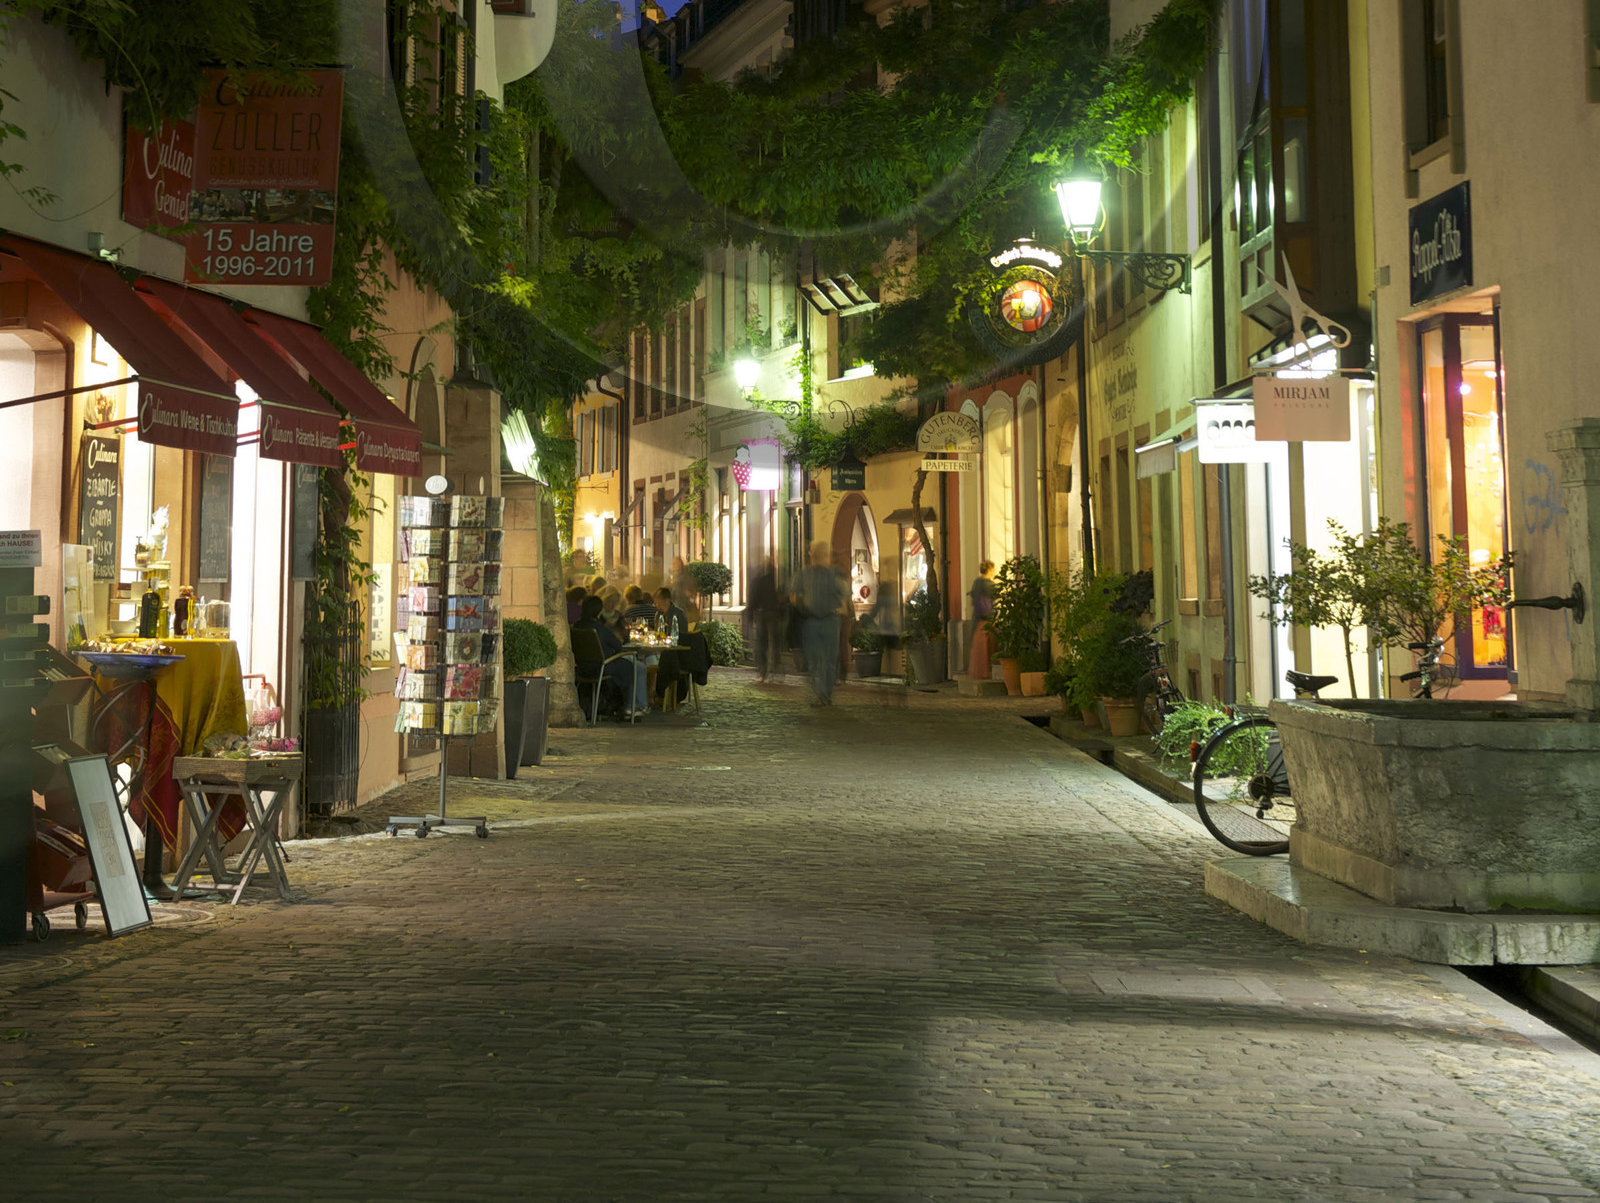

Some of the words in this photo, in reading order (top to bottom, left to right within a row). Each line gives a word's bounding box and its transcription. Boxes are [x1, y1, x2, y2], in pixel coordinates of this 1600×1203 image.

[211, 111, 323, 151] ZOLLER
[208, 156, 320, 177] GENUSSKULTUR
[203, 229, 232, 251] 15
[241, 229, 313, 253] Jahre
[202, 256, 315, 276] 1996-2011
[1273, 387, 1331, 402] MIRJAM
[140, 392, 179, 434] Culinara
[920, 414, 981, 446] GUTENBERG
[925, 461, 973, 471] PAPETERIE
